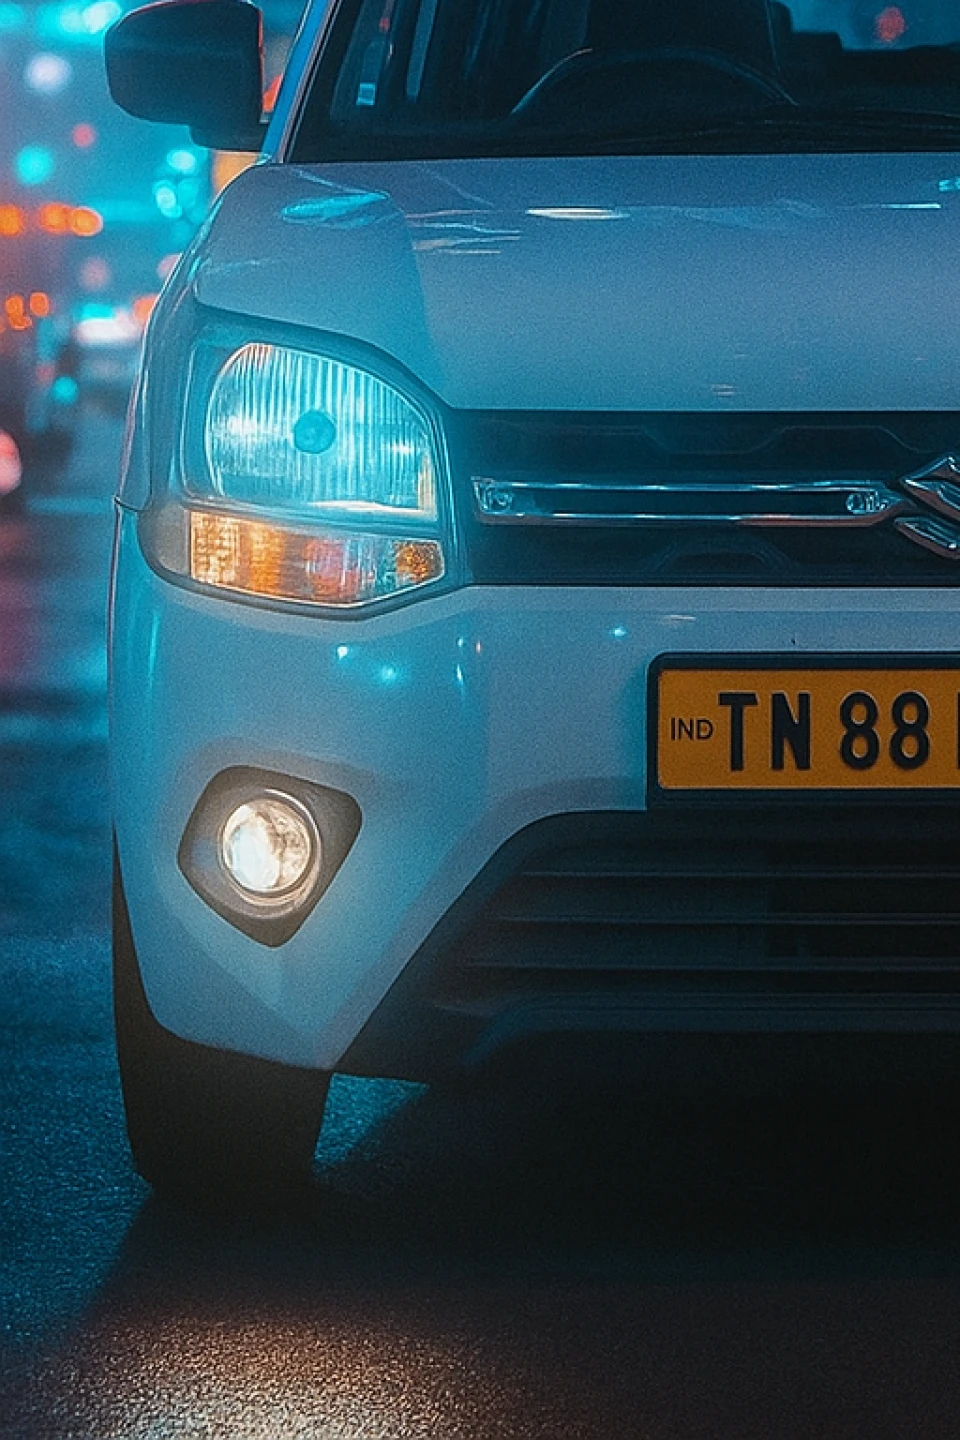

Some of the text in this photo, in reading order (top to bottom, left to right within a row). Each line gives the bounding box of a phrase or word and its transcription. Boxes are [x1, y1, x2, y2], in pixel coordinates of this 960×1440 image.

[669, 717, 715, 742] IND
[717, 691, 812, 773] TN
[837, 691, 932, 772] 88
